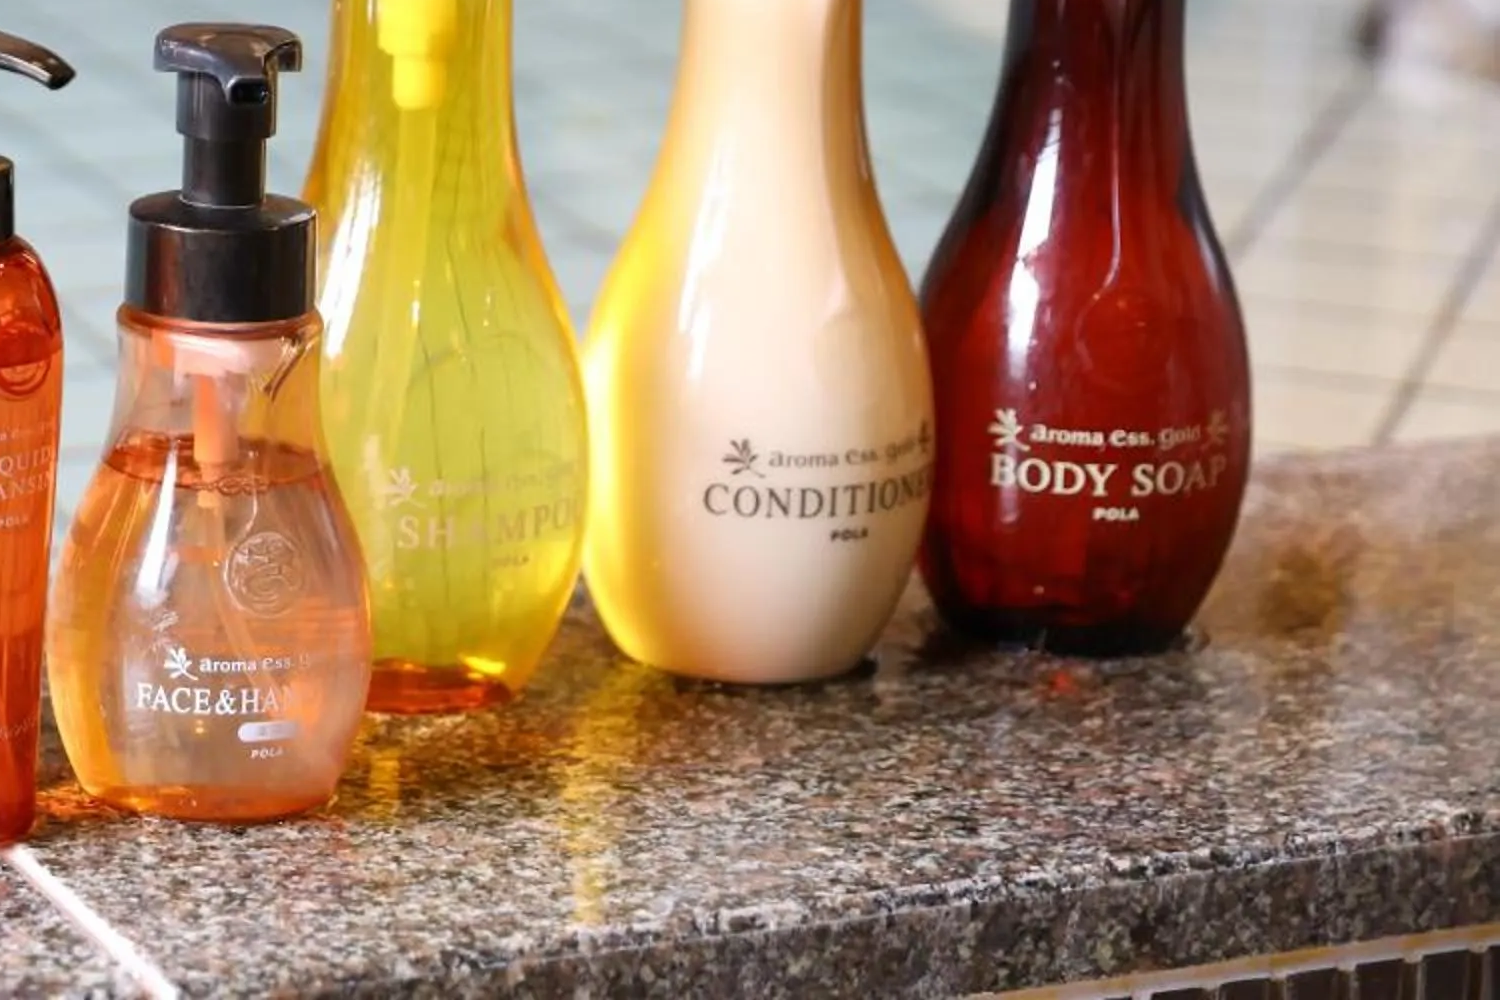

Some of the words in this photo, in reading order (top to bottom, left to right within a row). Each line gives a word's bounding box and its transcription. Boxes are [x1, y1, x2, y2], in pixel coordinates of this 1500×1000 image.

[1029, 424, 1104, 447] aroma
[768, 449, 839, 468] aroma
[991, 453, 1117, 497] BODY
[1130, 453, 1228, 497] SOAP
[1092, 506, 1140, 521] POLA
[829, 527, 869, 542] POLA
[199, 657, 257, 674] aroma
[250, 747, 285, 760] POLA
